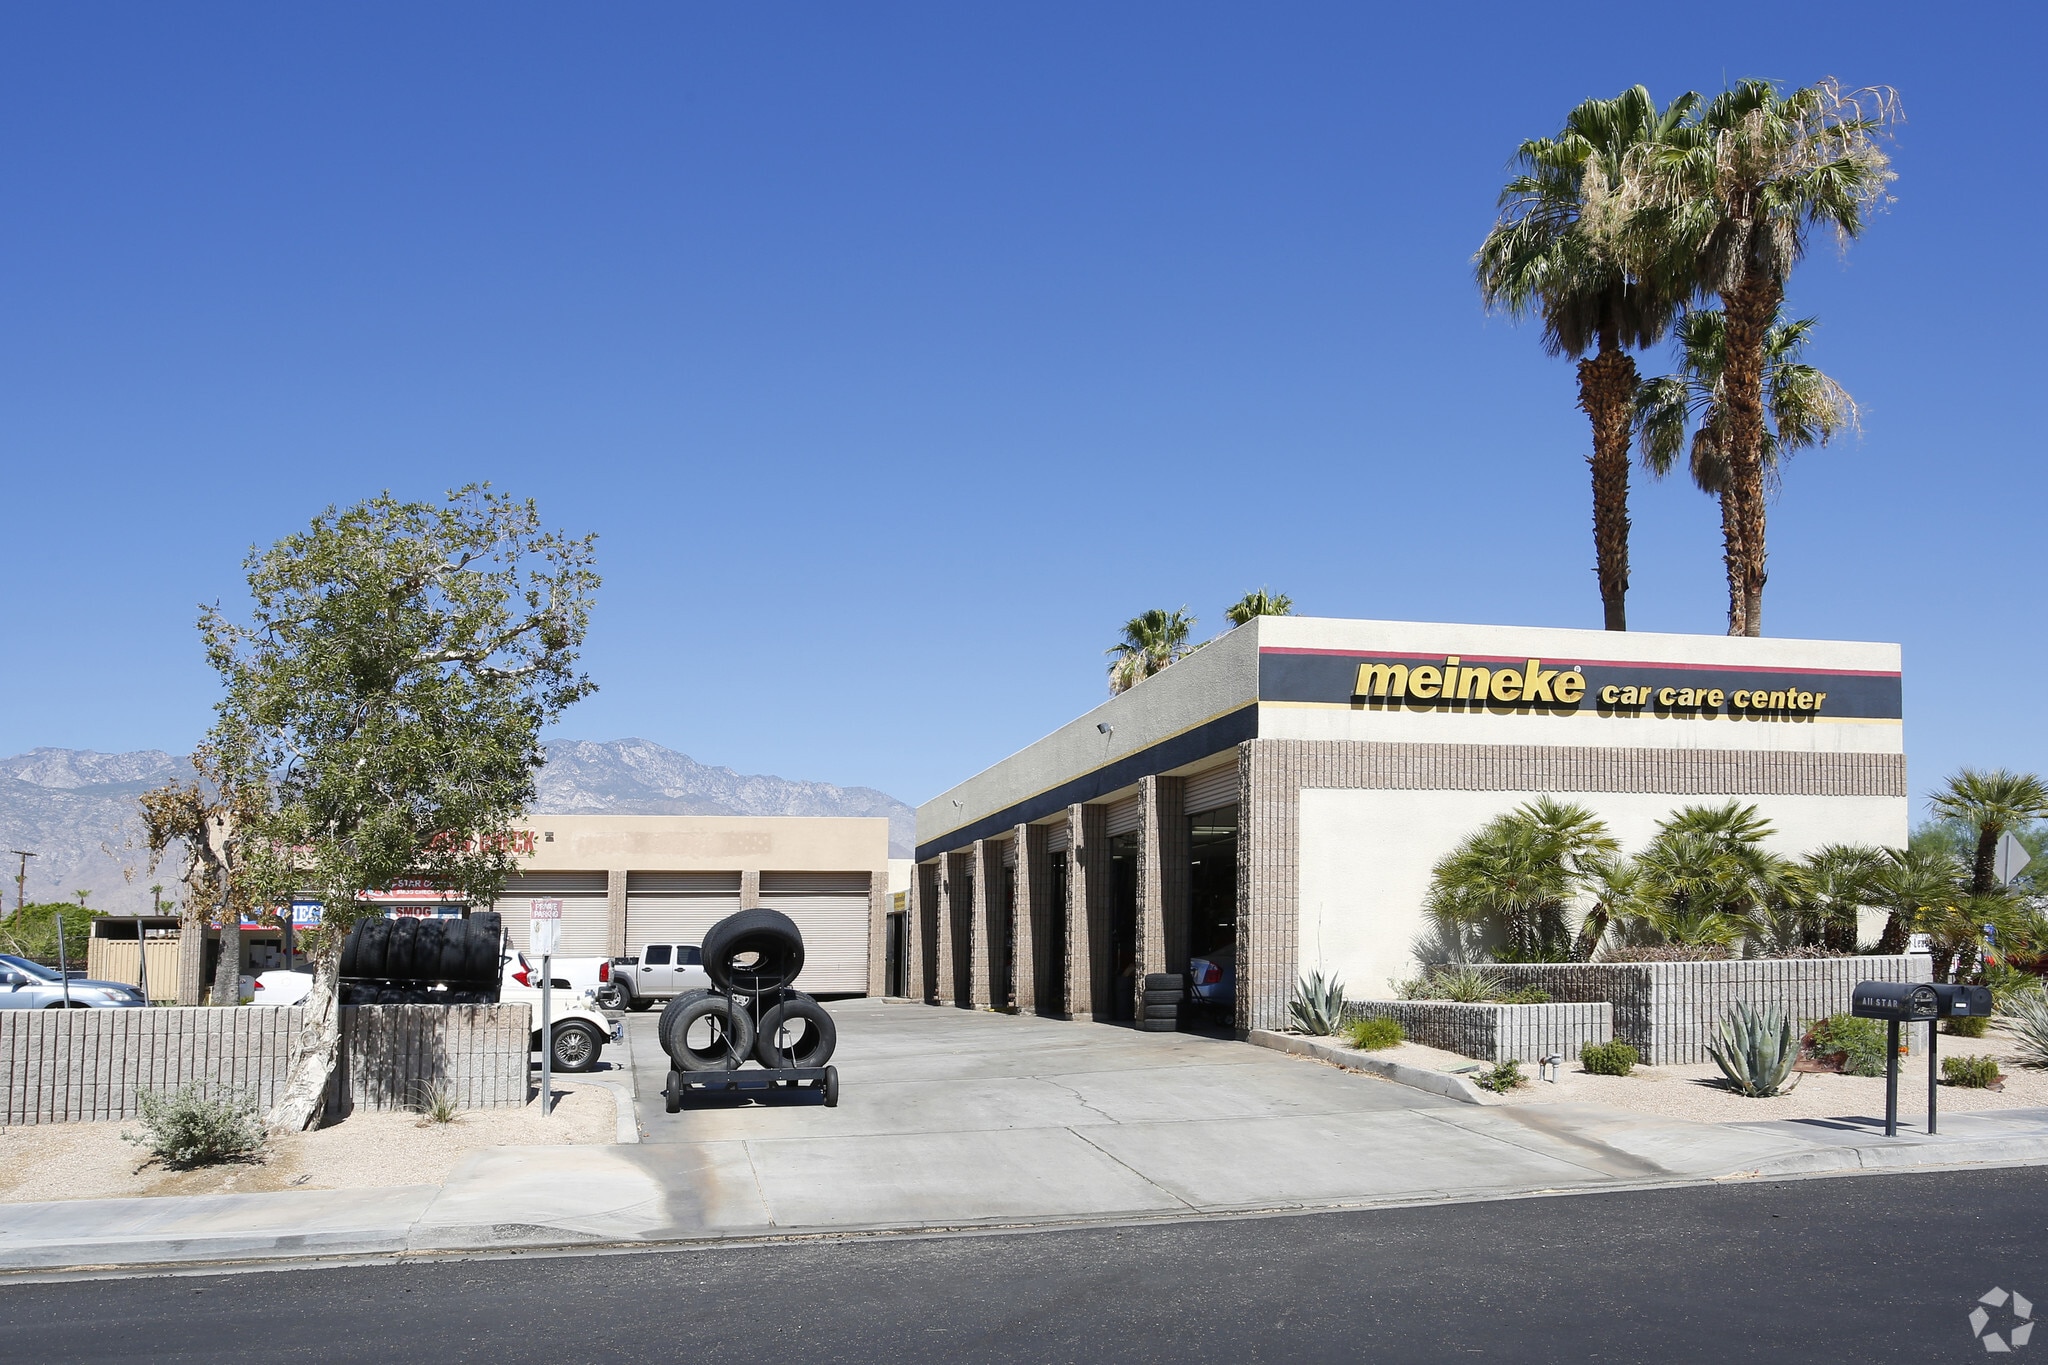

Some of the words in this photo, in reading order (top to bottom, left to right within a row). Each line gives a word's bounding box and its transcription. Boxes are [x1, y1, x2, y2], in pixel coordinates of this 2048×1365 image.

[1355, 656, 1586, 703] meineke
[1602, 684, 1652, 705] car
[1659, 687, 1724, 708] care
[1733, 687, 1826, 710] center
[398, 879, 421, 888] STAR
[395, 906, 432, 918] SMOG
[1875, 998, 1898, 1008] STAR
